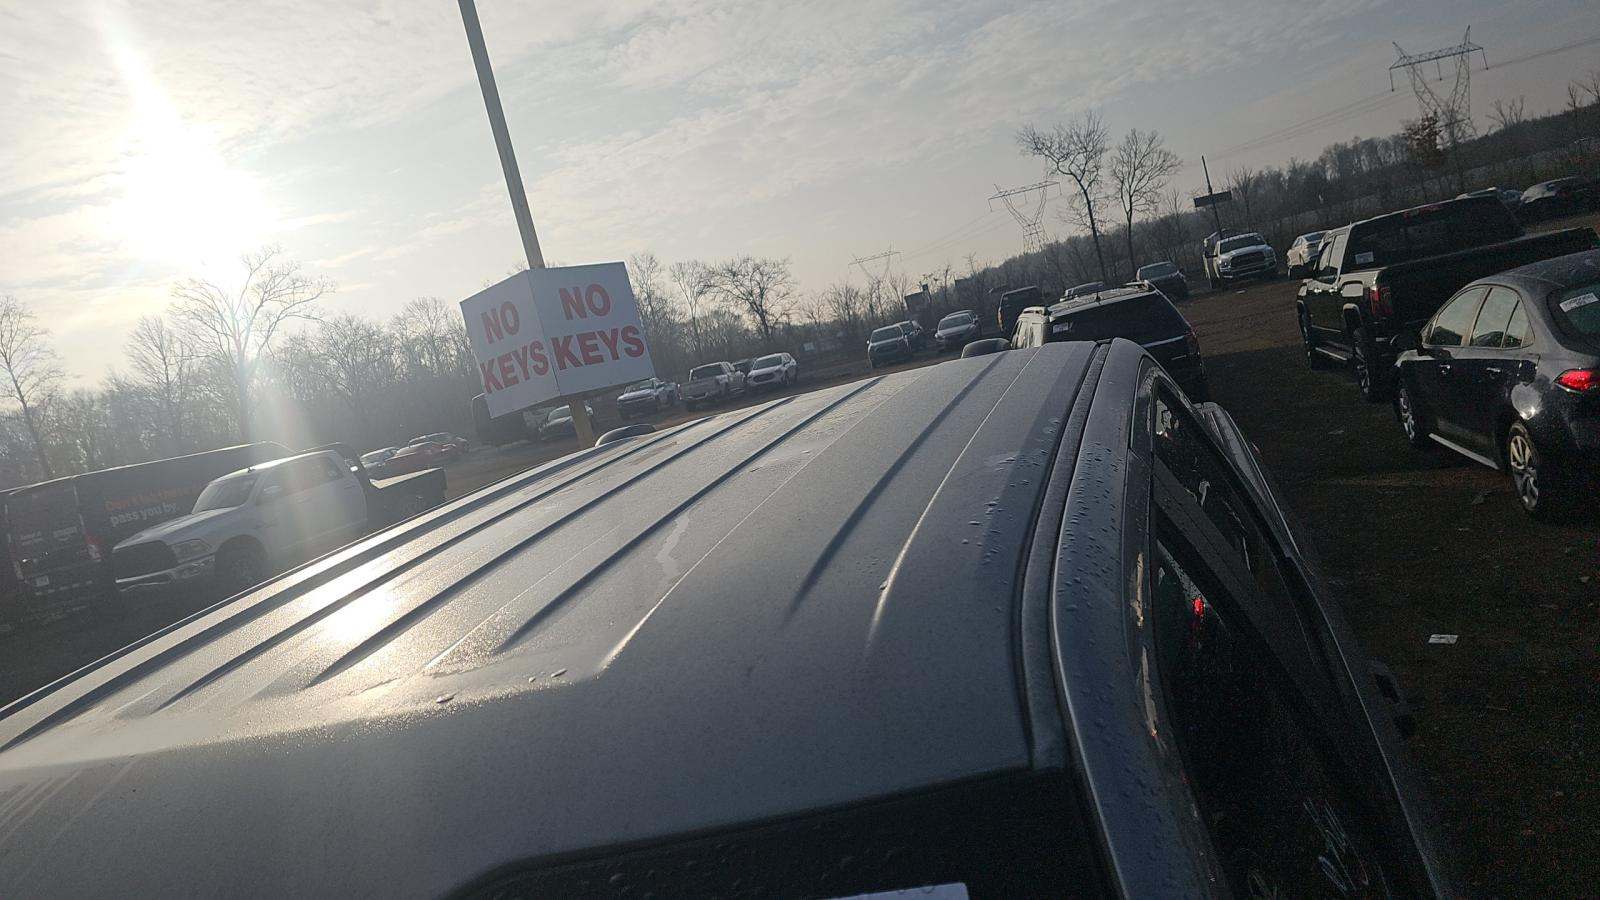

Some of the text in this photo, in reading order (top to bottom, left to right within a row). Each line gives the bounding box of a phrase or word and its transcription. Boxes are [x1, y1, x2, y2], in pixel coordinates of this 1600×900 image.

[480, 301, 520, 344] NO
[559, 283, 612, 320] NO
[479, 341, 550, 394] KEYS
[550, 325, 645, 370] KEYS
[139, 505, 162, 521] you
